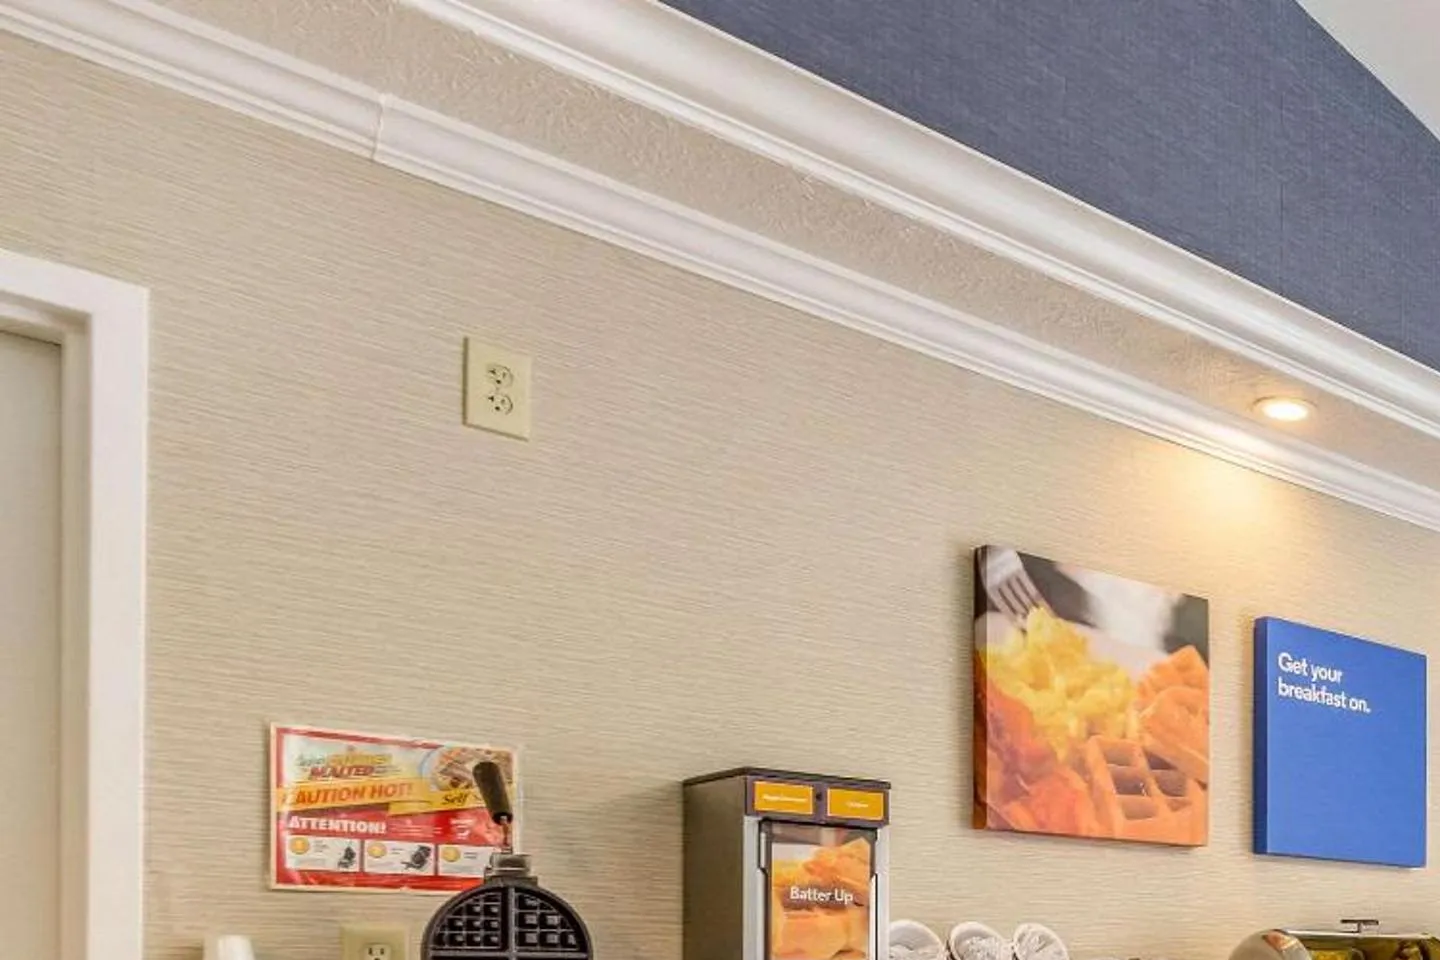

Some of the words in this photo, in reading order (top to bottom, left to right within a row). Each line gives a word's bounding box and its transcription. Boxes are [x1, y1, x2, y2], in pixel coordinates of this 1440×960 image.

[1278, 652, 1308, 676] Get
[1311, 665, 1344, 684] your
[1278, 676, 1347, 709] breakfast
[1349, 699, 1372, 714] on.
[286, 786, 367, 805] AUTION
[288, 815, 387, 835] ATTENTION!
[789, 885, 832, 902] Batter
[834, 888, 854, 905] Up
